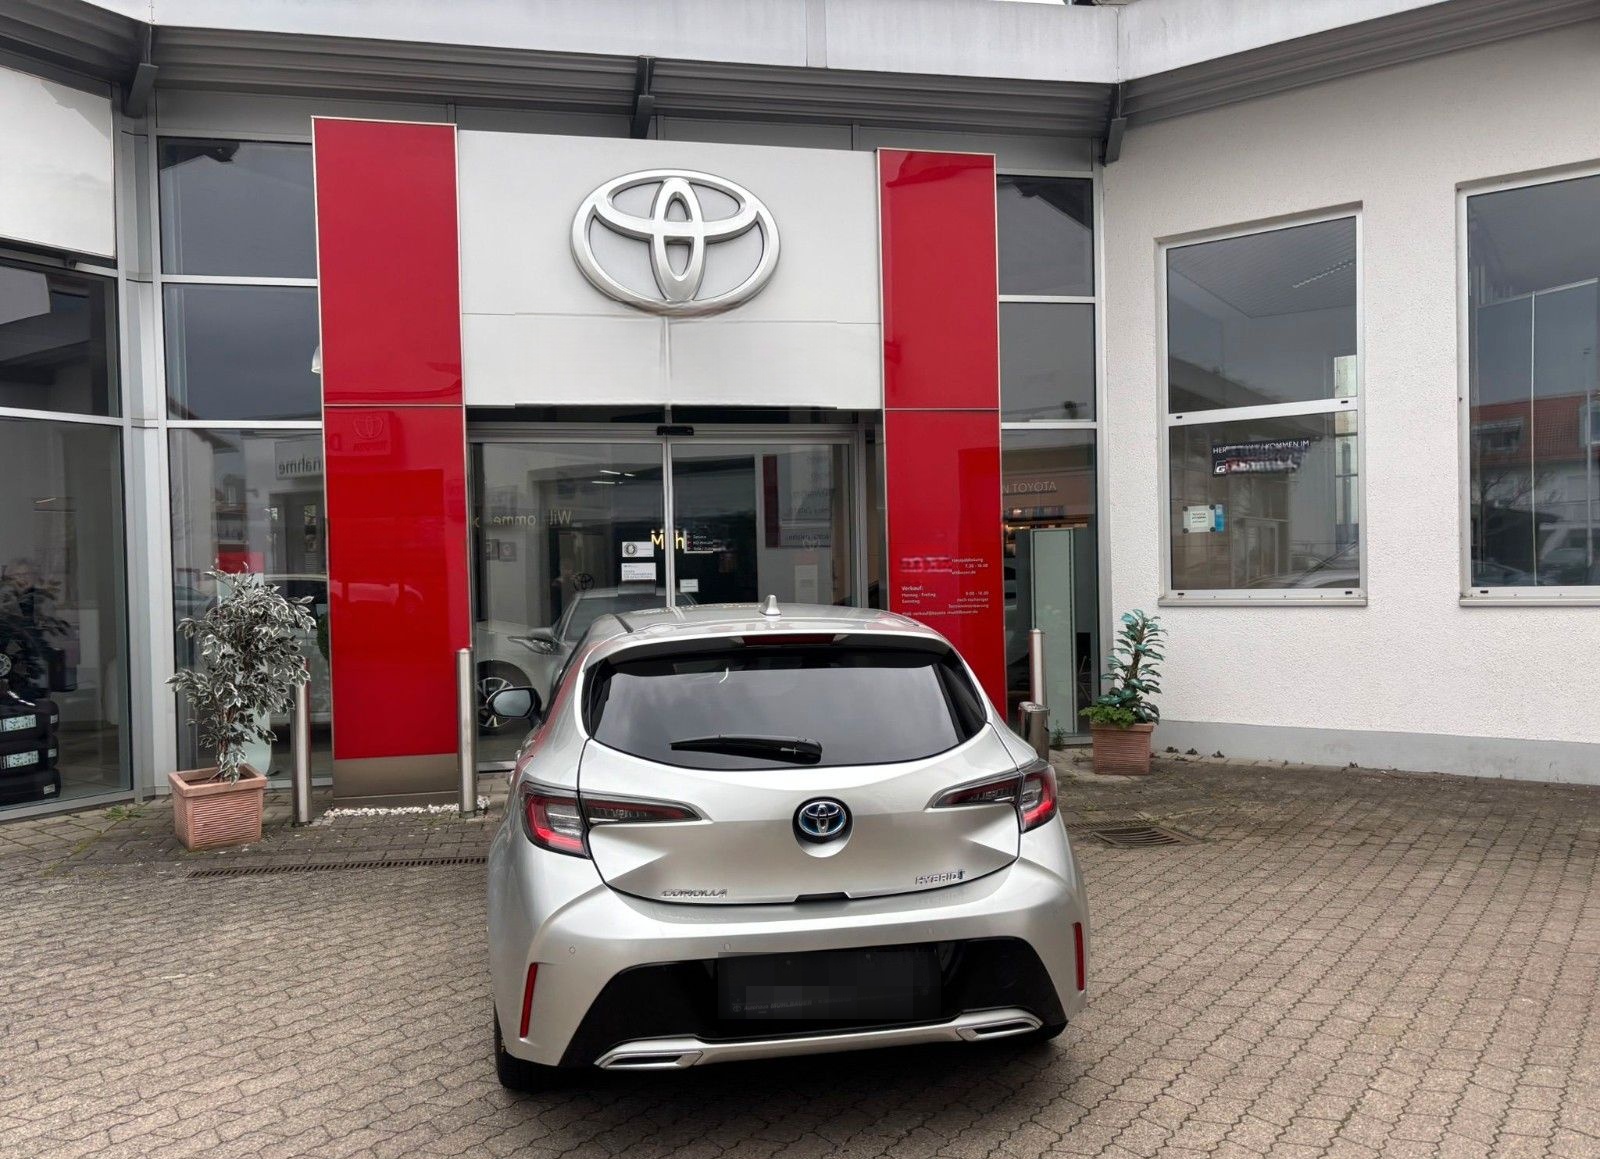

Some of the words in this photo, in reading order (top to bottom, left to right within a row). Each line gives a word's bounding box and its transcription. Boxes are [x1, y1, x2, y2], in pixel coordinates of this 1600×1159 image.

[1012, 481, 1057, 493] TOYOTA
[915, 872, 957, 886] HYBRID
[661, 888, 728, 899] COROLLA
